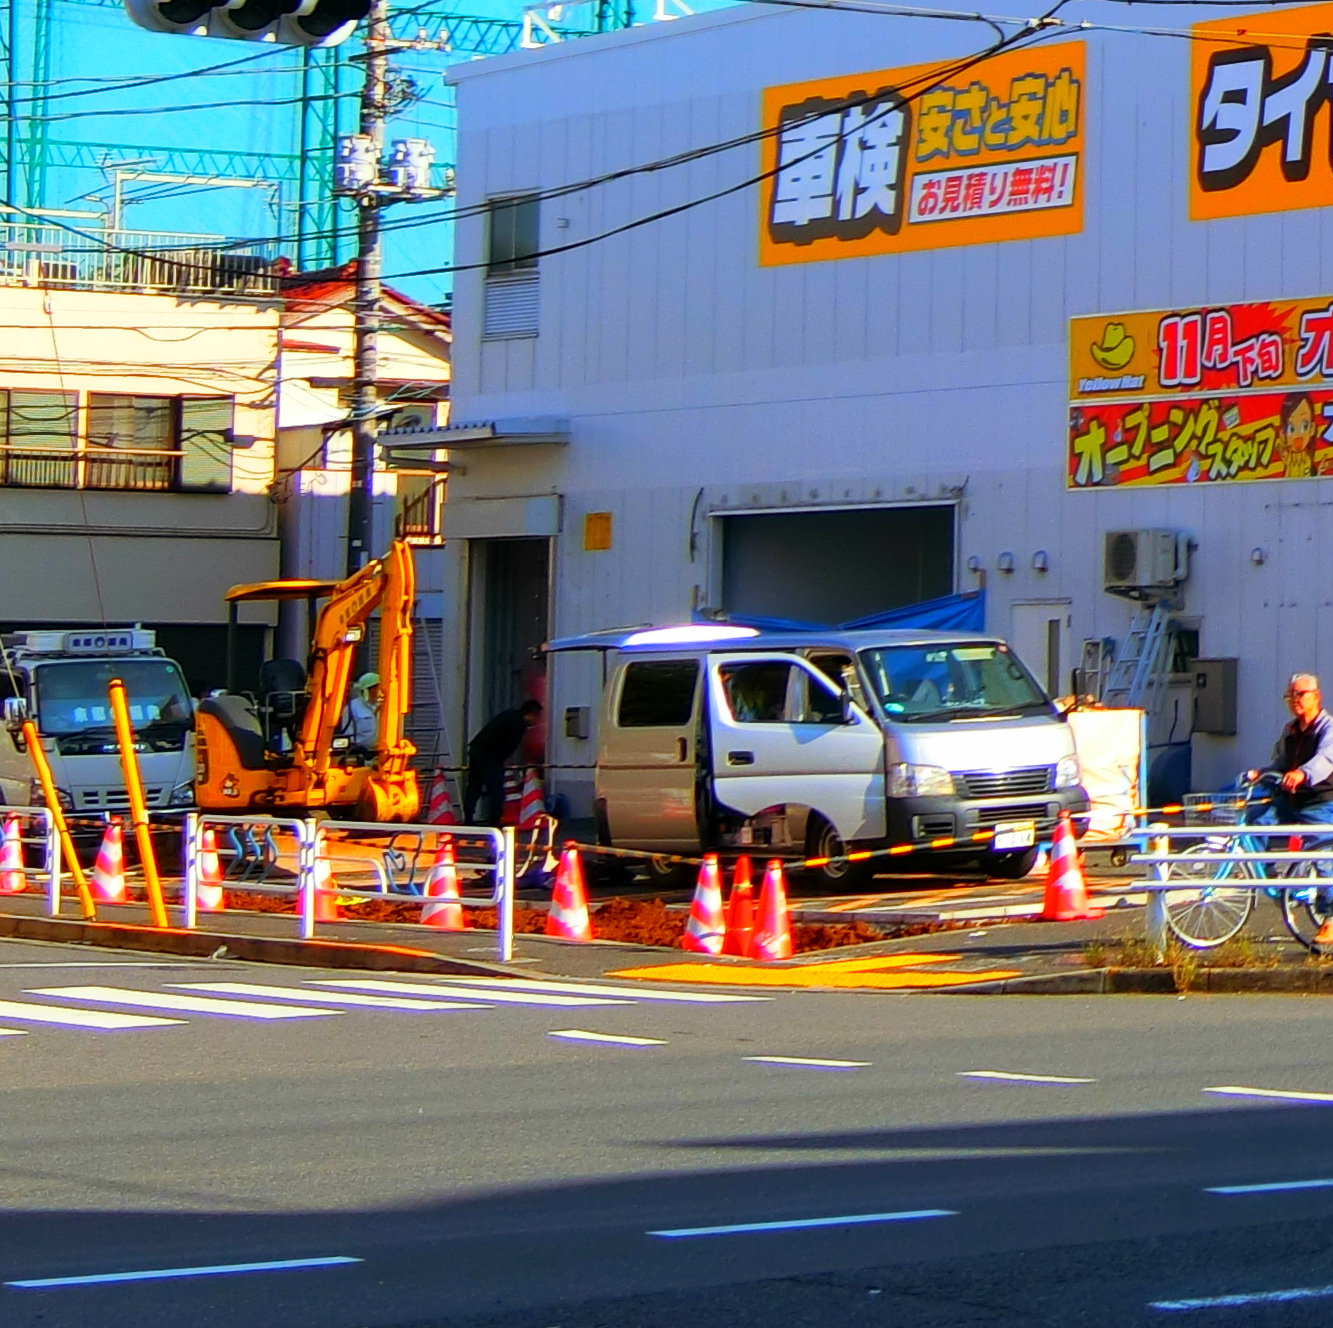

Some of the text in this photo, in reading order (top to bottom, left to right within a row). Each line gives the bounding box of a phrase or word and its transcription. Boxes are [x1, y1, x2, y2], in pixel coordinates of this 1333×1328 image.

[916, 69, 1079, 161] 安さと安心
[770, 94, 907, 234] 車検
[917, 162, 1069, 217] お見積り無料!
[1159, 310, 1284, 387] 11月下旬
[1072, 399, 1220, 486] オープニング
[1208, 425, 1277, 480] スタッフ
